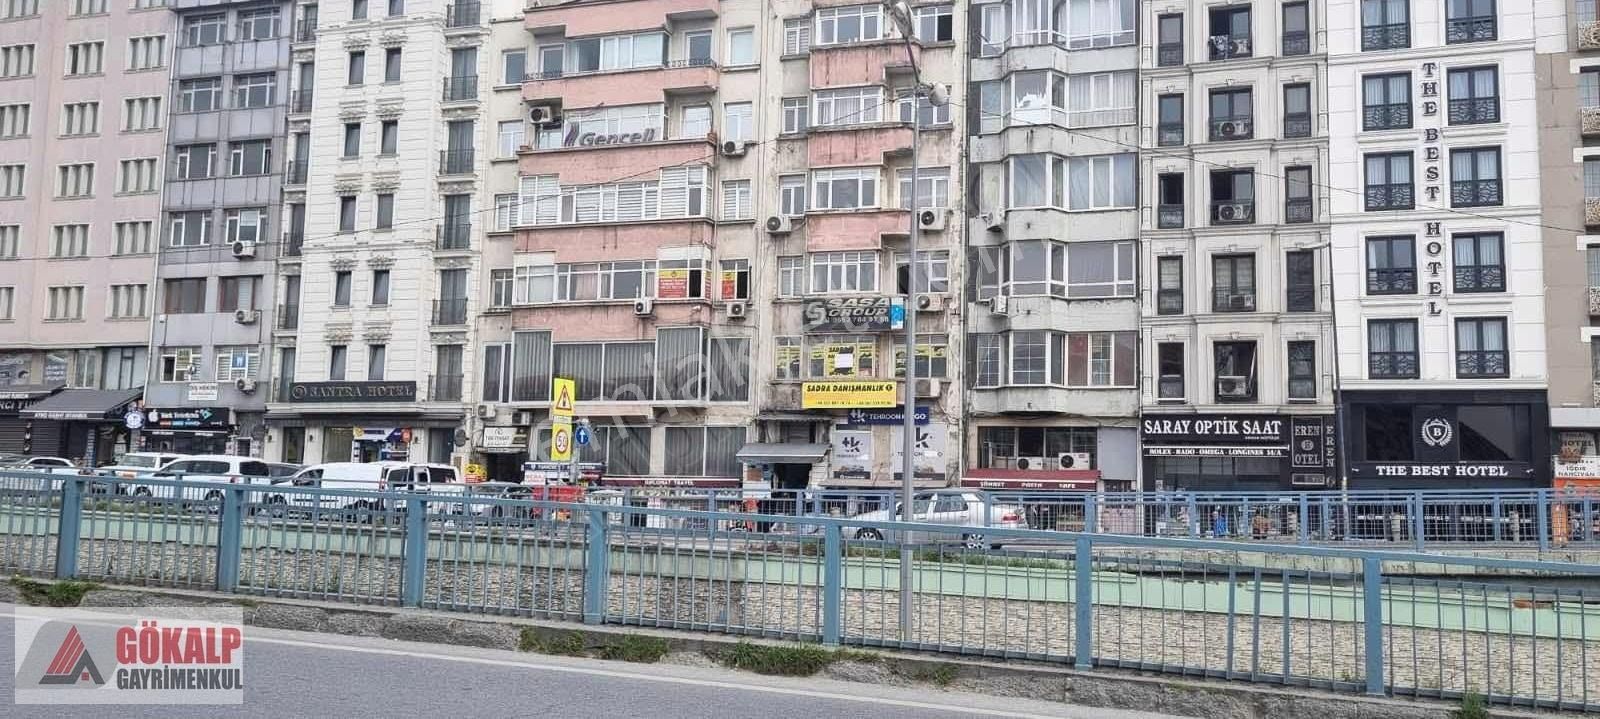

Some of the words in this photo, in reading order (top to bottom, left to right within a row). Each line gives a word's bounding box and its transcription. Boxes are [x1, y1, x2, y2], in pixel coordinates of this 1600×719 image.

[1420, 62, 1438, 116] THE
[1423, 128, 1441, 202] BEST
[1426, 221, 1443, 317] HOTEL
[825, 297, 890, 307] SASA
[828, 307, 888, 317] GROUP
[310, 386, 362, 397] SANTRA
[367, 385, 413, 397] HOTEL
[806, 384, 831, 392] SADRA
[1144, 419, 1191, 434] SARAY
[1195, 416, 1239, 434] OPTİK
[1242, 419, 1282, 435] SAAT
[1294, 425, 1321, 436] EREN
[1325, 425, 1336, 467] EREN
[1294, 453, 1321, 464] OTEL
[1376, 465, 1407, 477] THE
[1411, 465, 1451, 477] BEST
[1455, 465, 1509, 477] HOTEL
